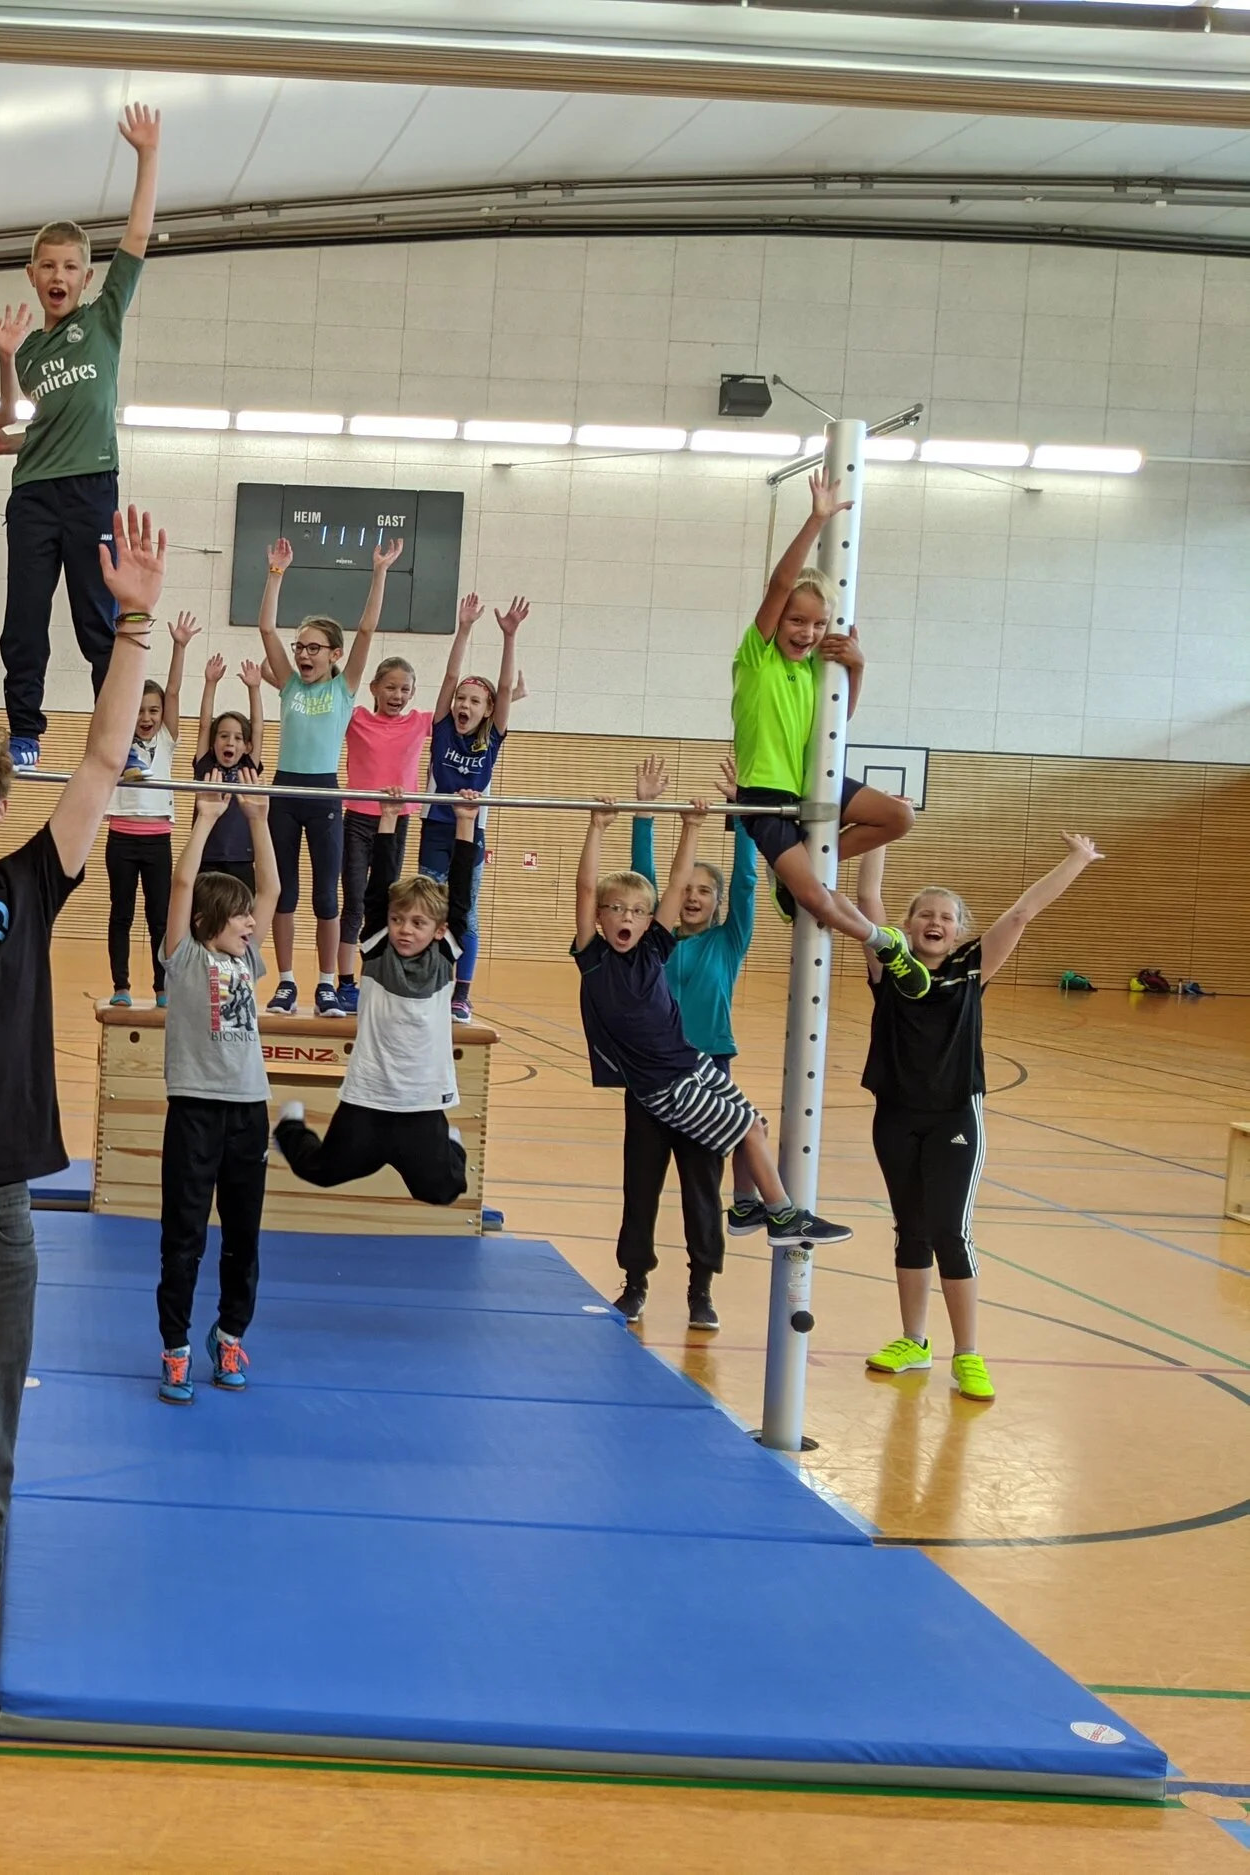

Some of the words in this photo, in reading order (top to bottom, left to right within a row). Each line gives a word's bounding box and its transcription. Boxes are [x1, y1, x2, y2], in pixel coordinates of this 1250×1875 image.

[41, 357, 65, 376] Fly
[293, 511, 322, 524] HEIM
[377, 514, 406, 527] GAST
[444, 747, 486, 768] HEITEC
[211, 1030, 259, 1042] BIONIC
